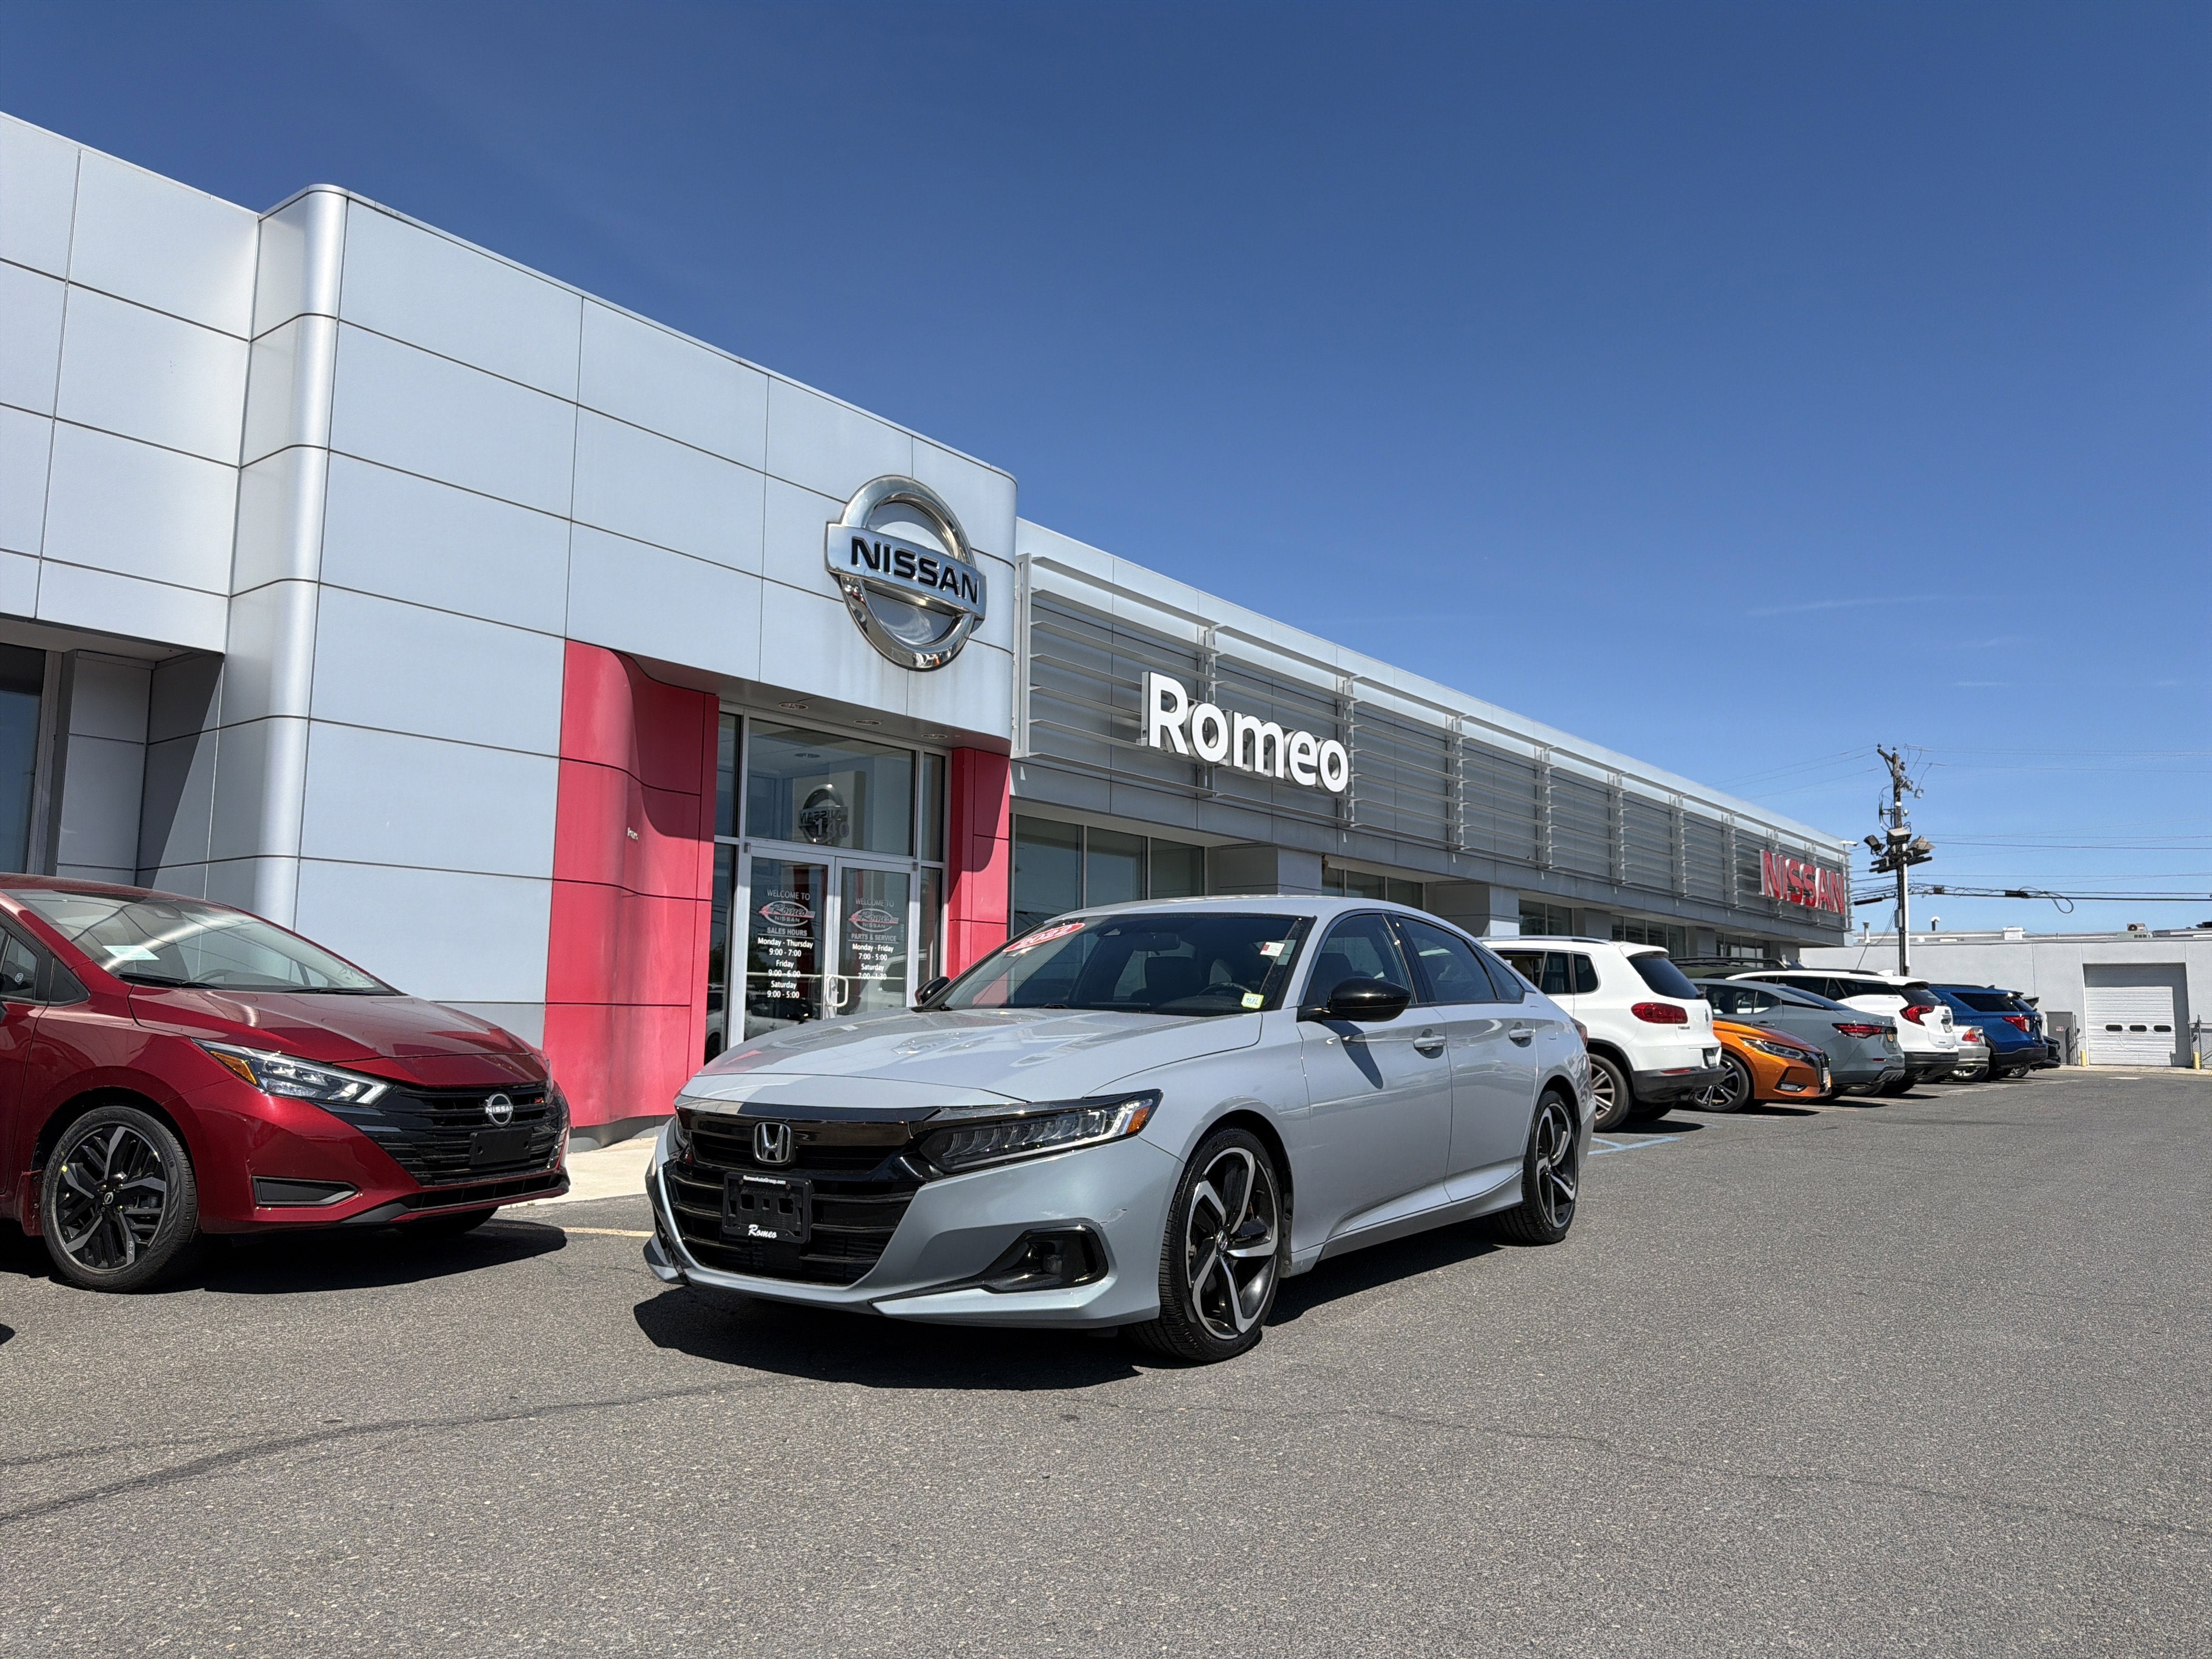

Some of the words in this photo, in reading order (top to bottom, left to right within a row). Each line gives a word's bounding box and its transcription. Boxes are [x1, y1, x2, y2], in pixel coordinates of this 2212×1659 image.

[851, 535, 979, 606] NISSAN
[1141, 670, 1349, 792] Romeo
[1759, 849, 1845, 915] NISSAN
[767, 889, 799, 899] WELCOME
[856, 898, 884, 906] WELCOME
[772, 903, 806, 916] Romeo
[861, 911, 891, 922] Romeo
[787, 928, 808, 936] HOURS
[1014, 925, 1073, 947] 2022
[758, 937, 781, 946] Monday
[786, 939, 813, 949] Thursday
[853, 944, 873, 952] Monday
[878, 944, 894, 953] Friday
[776, 960, 794, 969] Friday
[861, 963, 884, 972] Saturday
[771, 980, 797, 989] Saturday
[748, 1224, 777, 1239] Romeo
